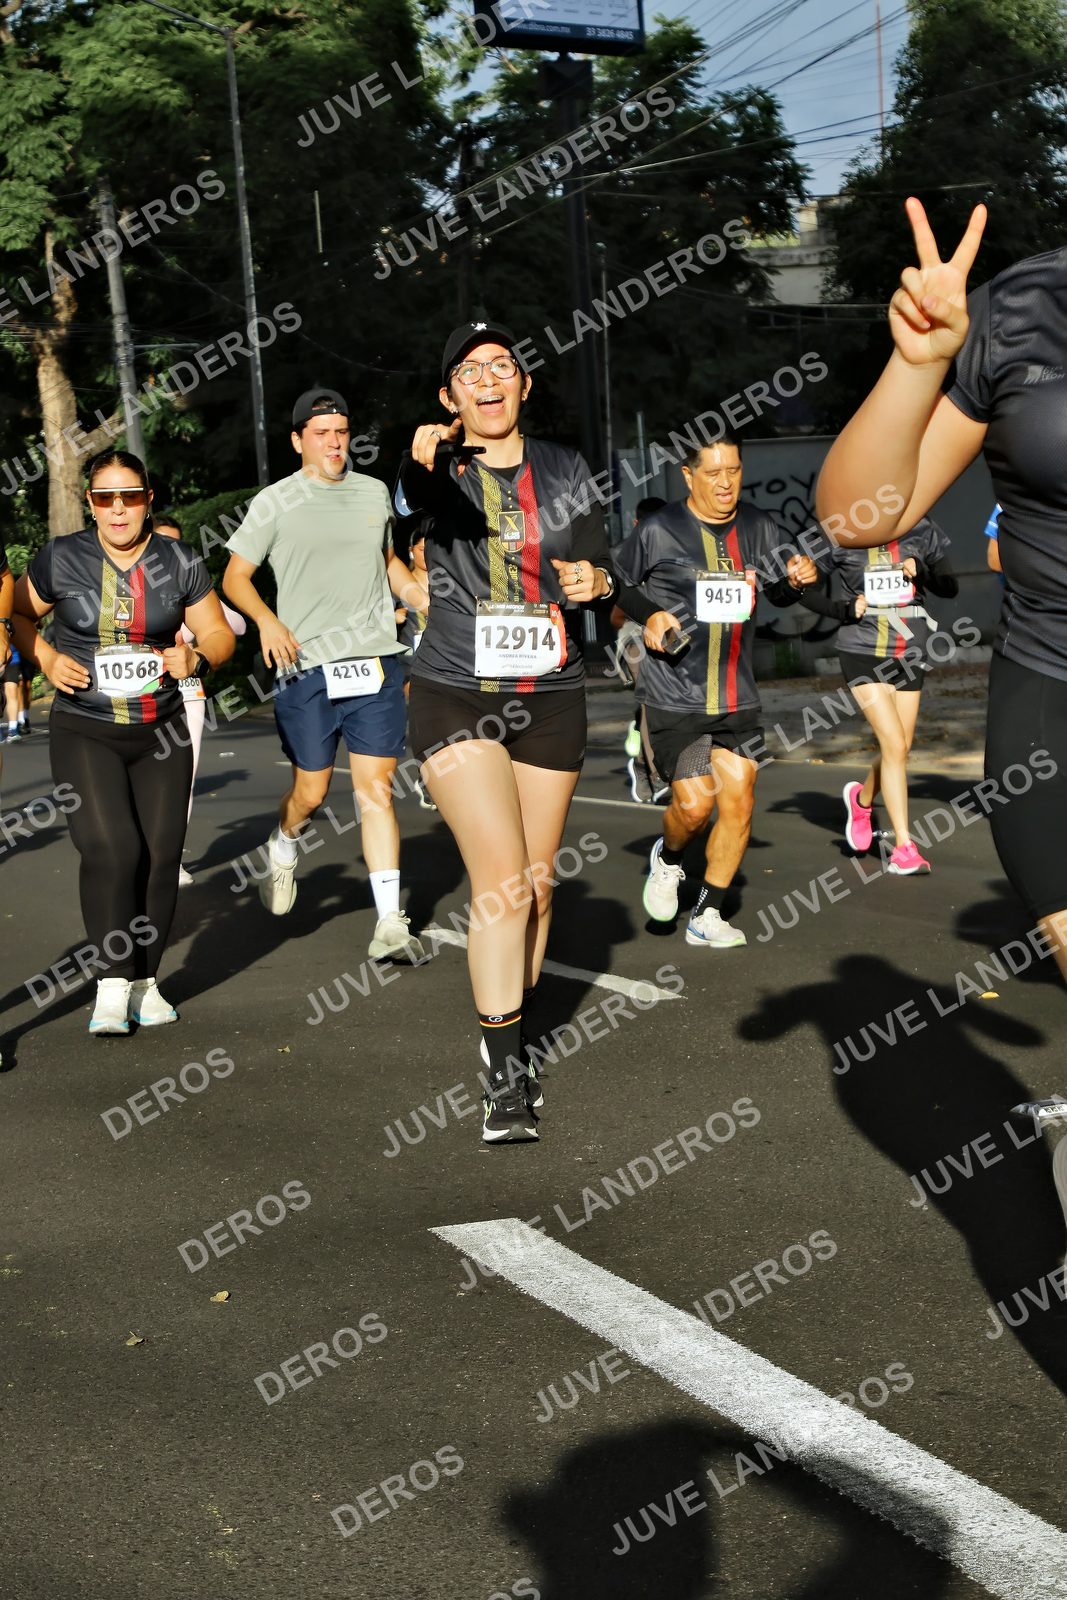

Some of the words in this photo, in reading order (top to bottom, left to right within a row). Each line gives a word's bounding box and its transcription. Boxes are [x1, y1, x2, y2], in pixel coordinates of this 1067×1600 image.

[705, 587, 741, 604] 9451
[481, 625, 556, 651] 12914
[100, 660, 159, 680] 10568
[333, 663, 370, 679] 4216
